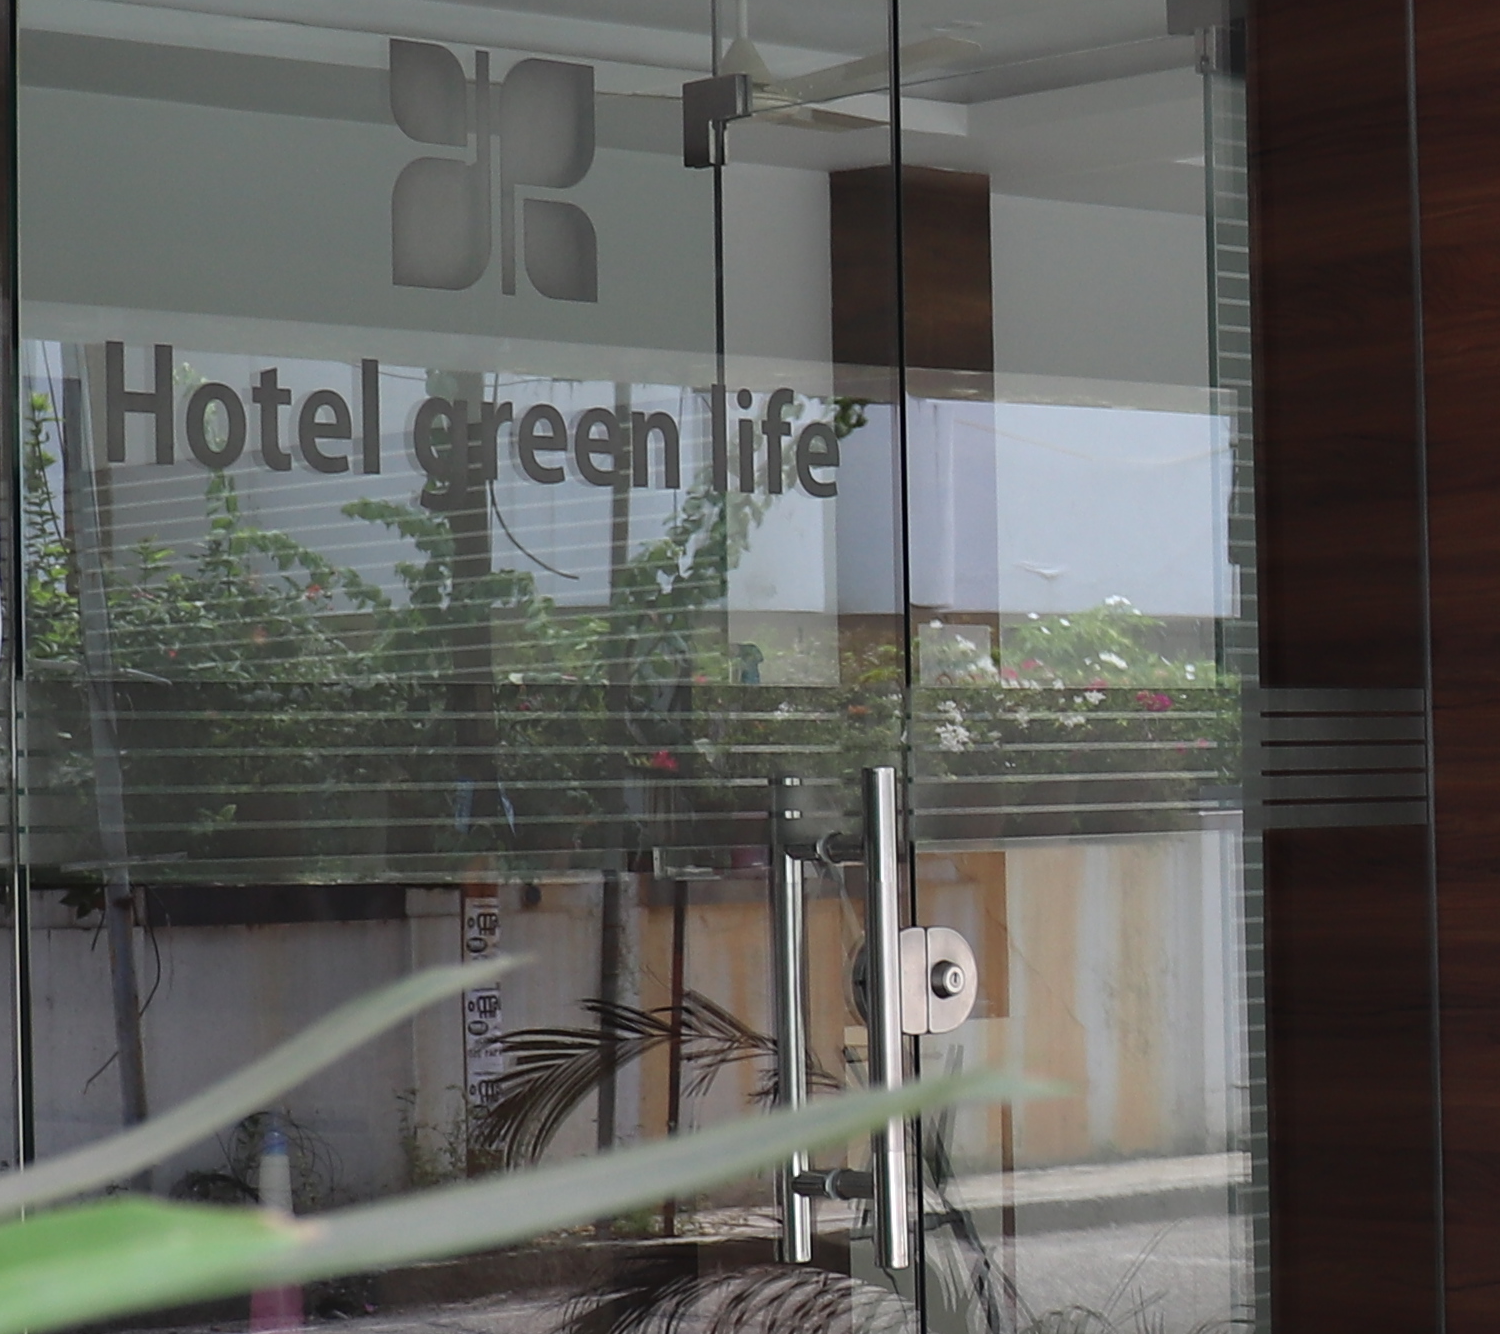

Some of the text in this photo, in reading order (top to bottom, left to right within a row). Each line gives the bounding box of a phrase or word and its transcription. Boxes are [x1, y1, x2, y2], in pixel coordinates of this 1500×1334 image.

[105, 340, 841, 508] Hotel green life
